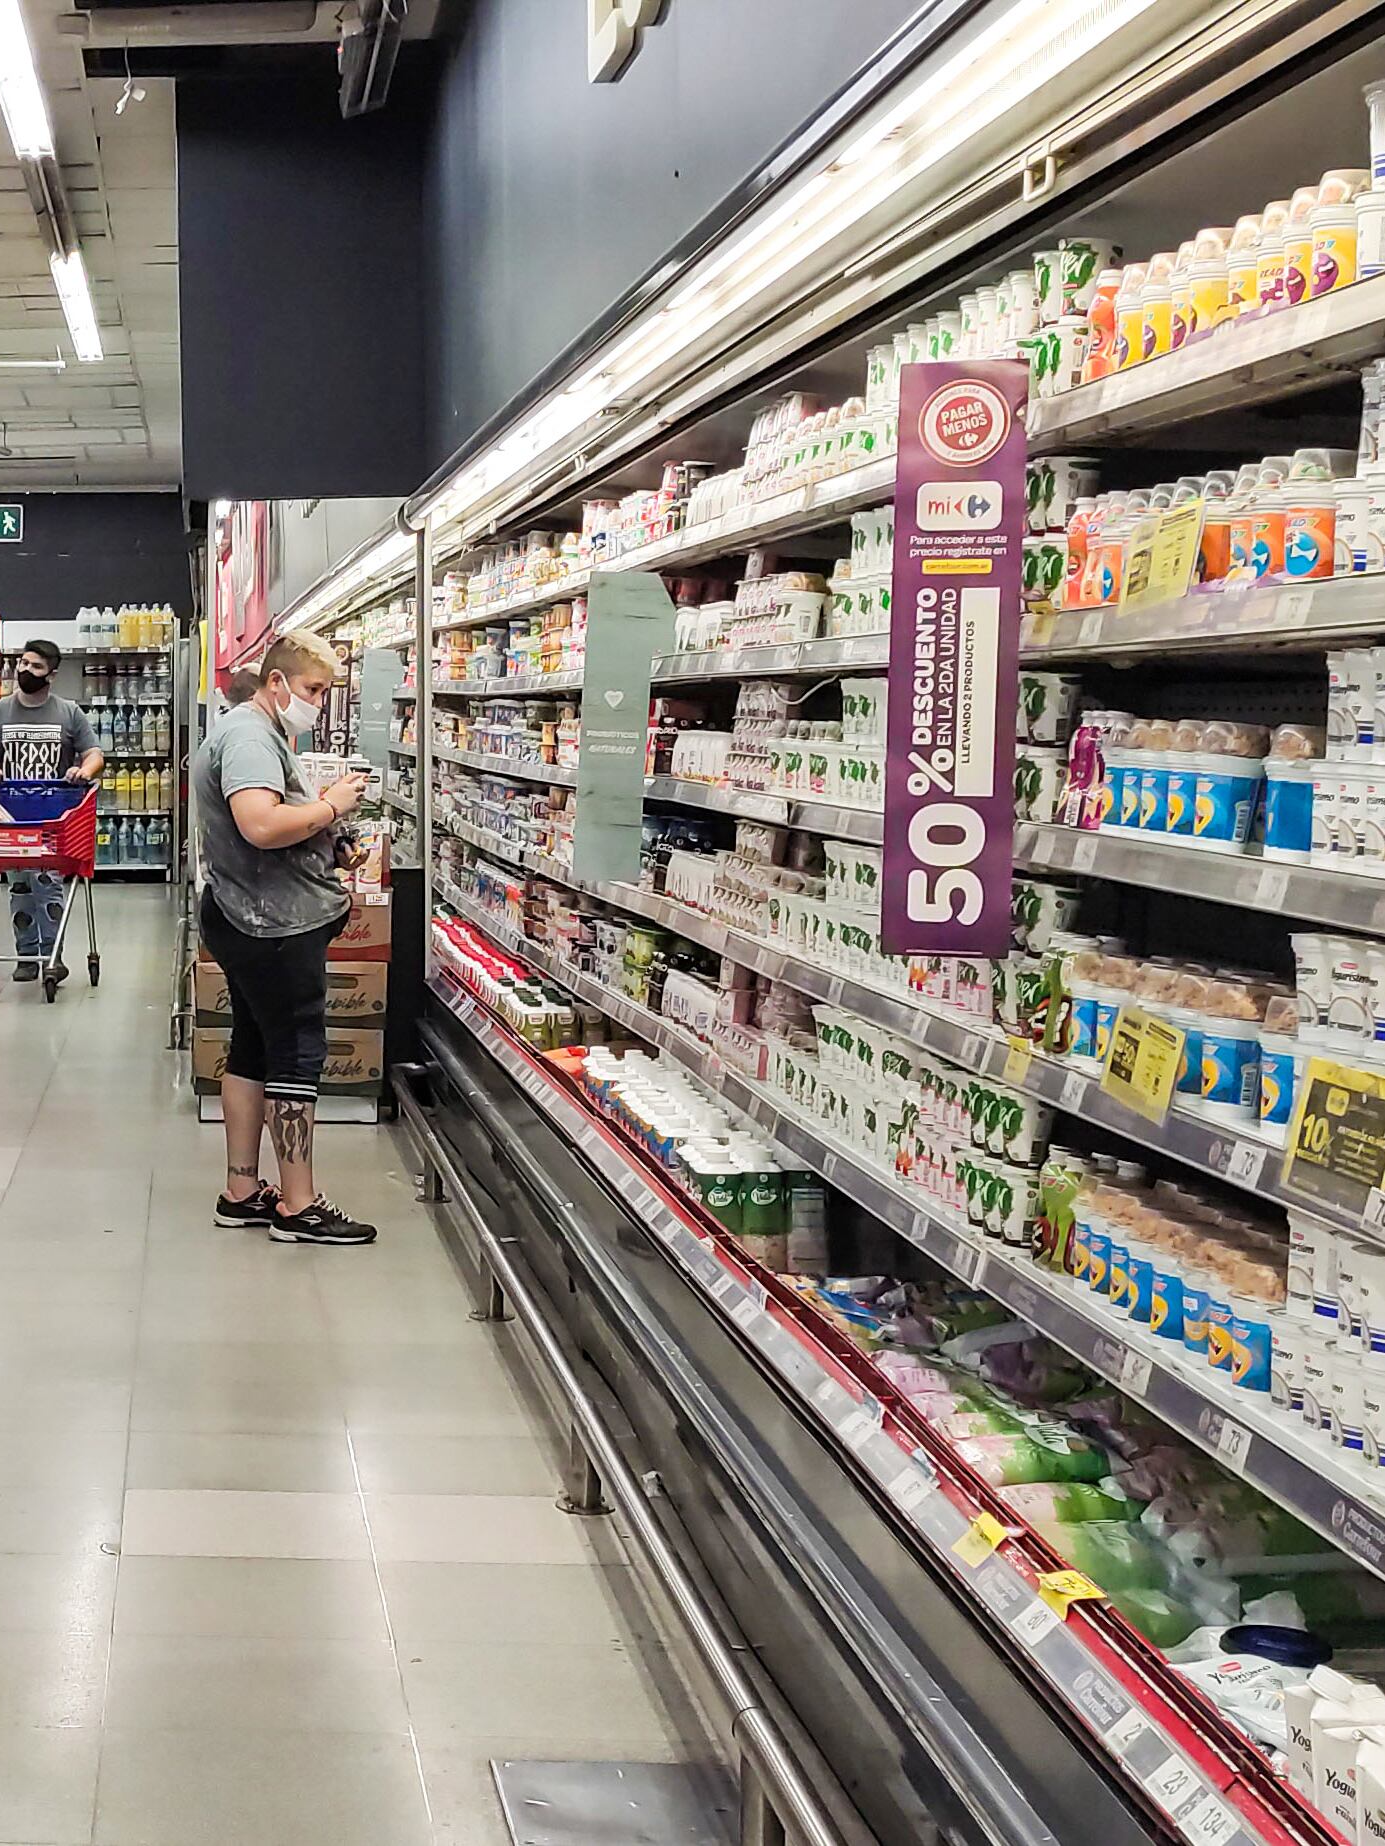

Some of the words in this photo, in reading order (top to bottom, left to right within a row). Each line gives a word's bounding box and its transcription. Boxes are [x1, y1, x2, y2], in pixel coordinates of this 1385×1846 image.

[941, 401, 983, 423] PAGAR
[942, 413, 988, 437] MENOS
[928, 496, 951, 515] mi
[910, 535, 933, 545] Para
[934, 535, 976, 544] acceder
[984, 535, 1008, 543] este
[910, 547, 942, 558] precio
[992, 547, 1007, 555] en
[939, 588, 957, 656] UNIDAD
[912, 587, 938, 745] DESCUENTO
[964, 620, 975, 692] PRODUCTOS
[938, 659, 956, 693] 2DA
[937, 697, 954, 718] LA
[936, 722, 952, 745] EN
[961, 703, 972, 764] LLEVANDO
[2, 742, 62, 764] WISDOM
[1163, 1770, 1189, 1795] 23
[1199, 1806, 1227, 1837] 134
